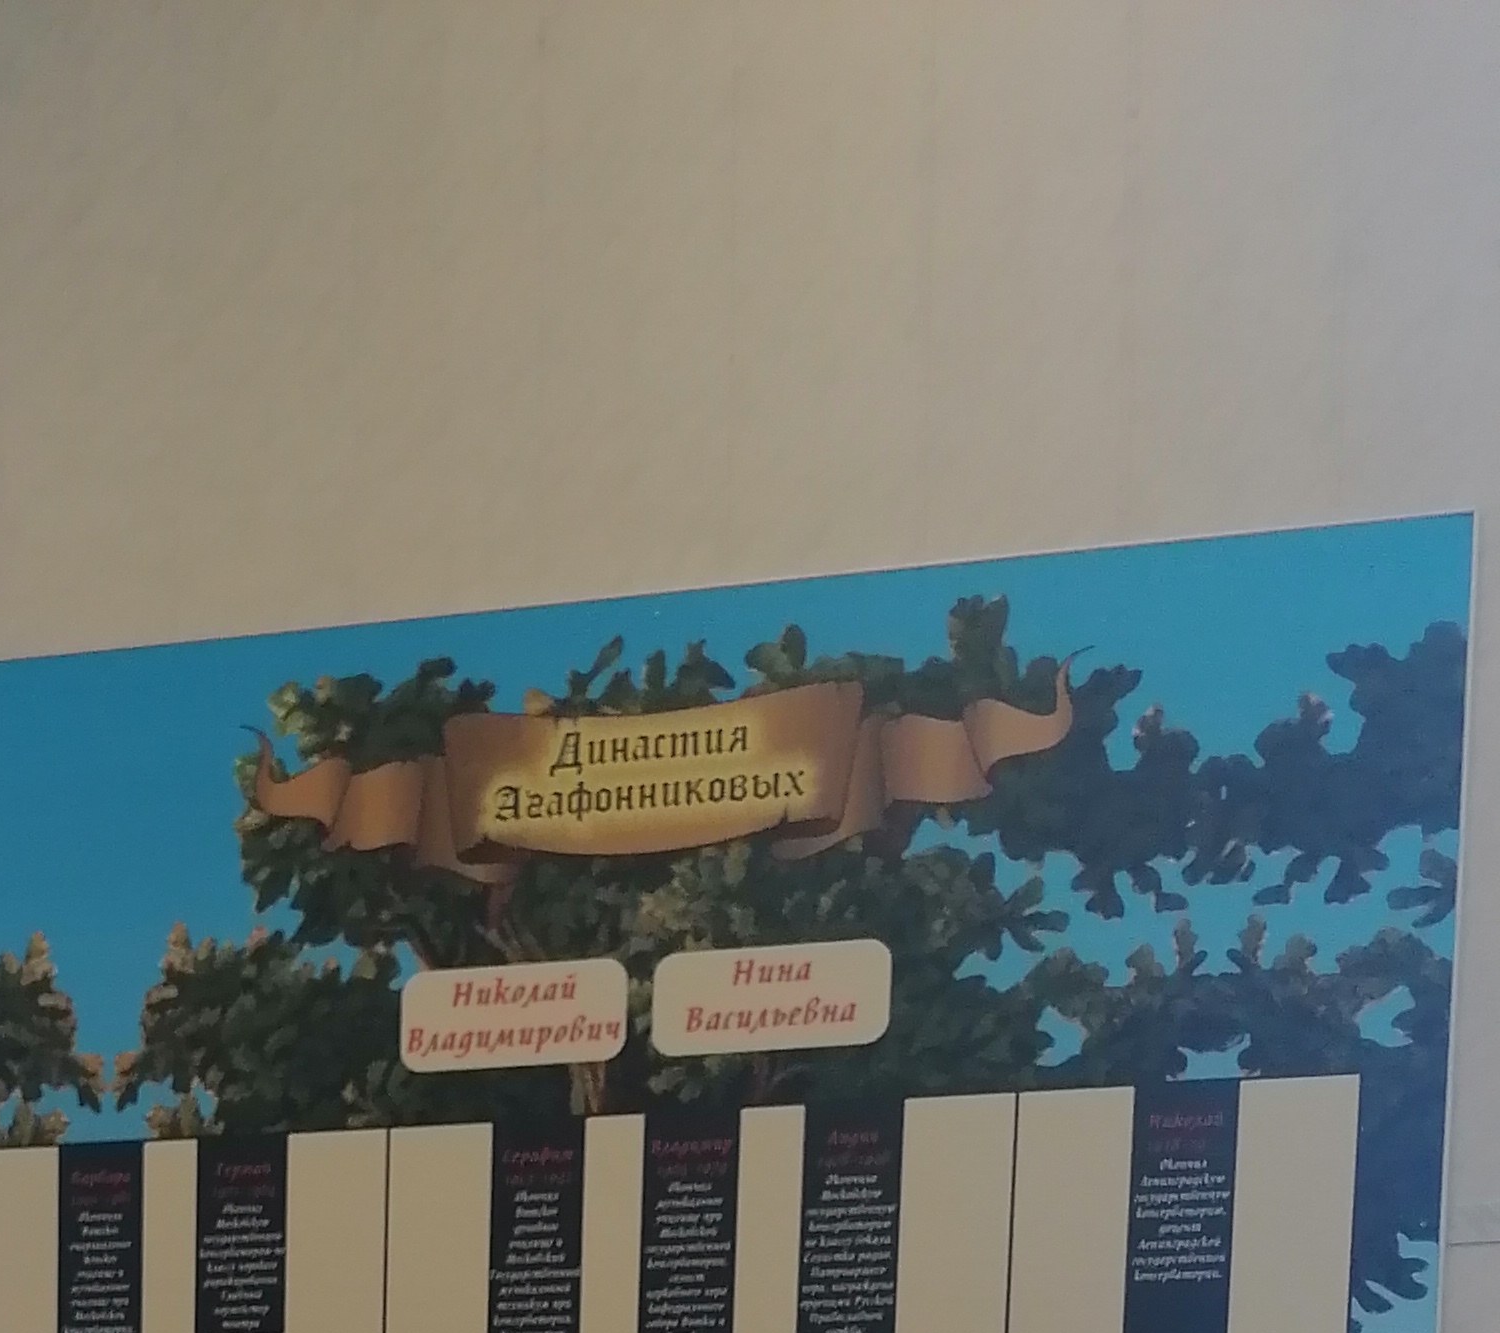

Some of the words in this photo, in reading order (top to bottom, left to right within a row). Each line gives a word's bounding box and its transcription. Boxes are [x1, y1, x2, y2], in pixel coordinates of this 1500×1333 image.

[550, 725, 748, 777] Династия
[494, 770, 804, 822] Агафонниковых
[452, 973, 576, 1009] Николай
[732, 959, 811, 986] Нина
[685, 995, 855, 1034] Васильевна
[406, 1014, 620, 1057] Владимирович
